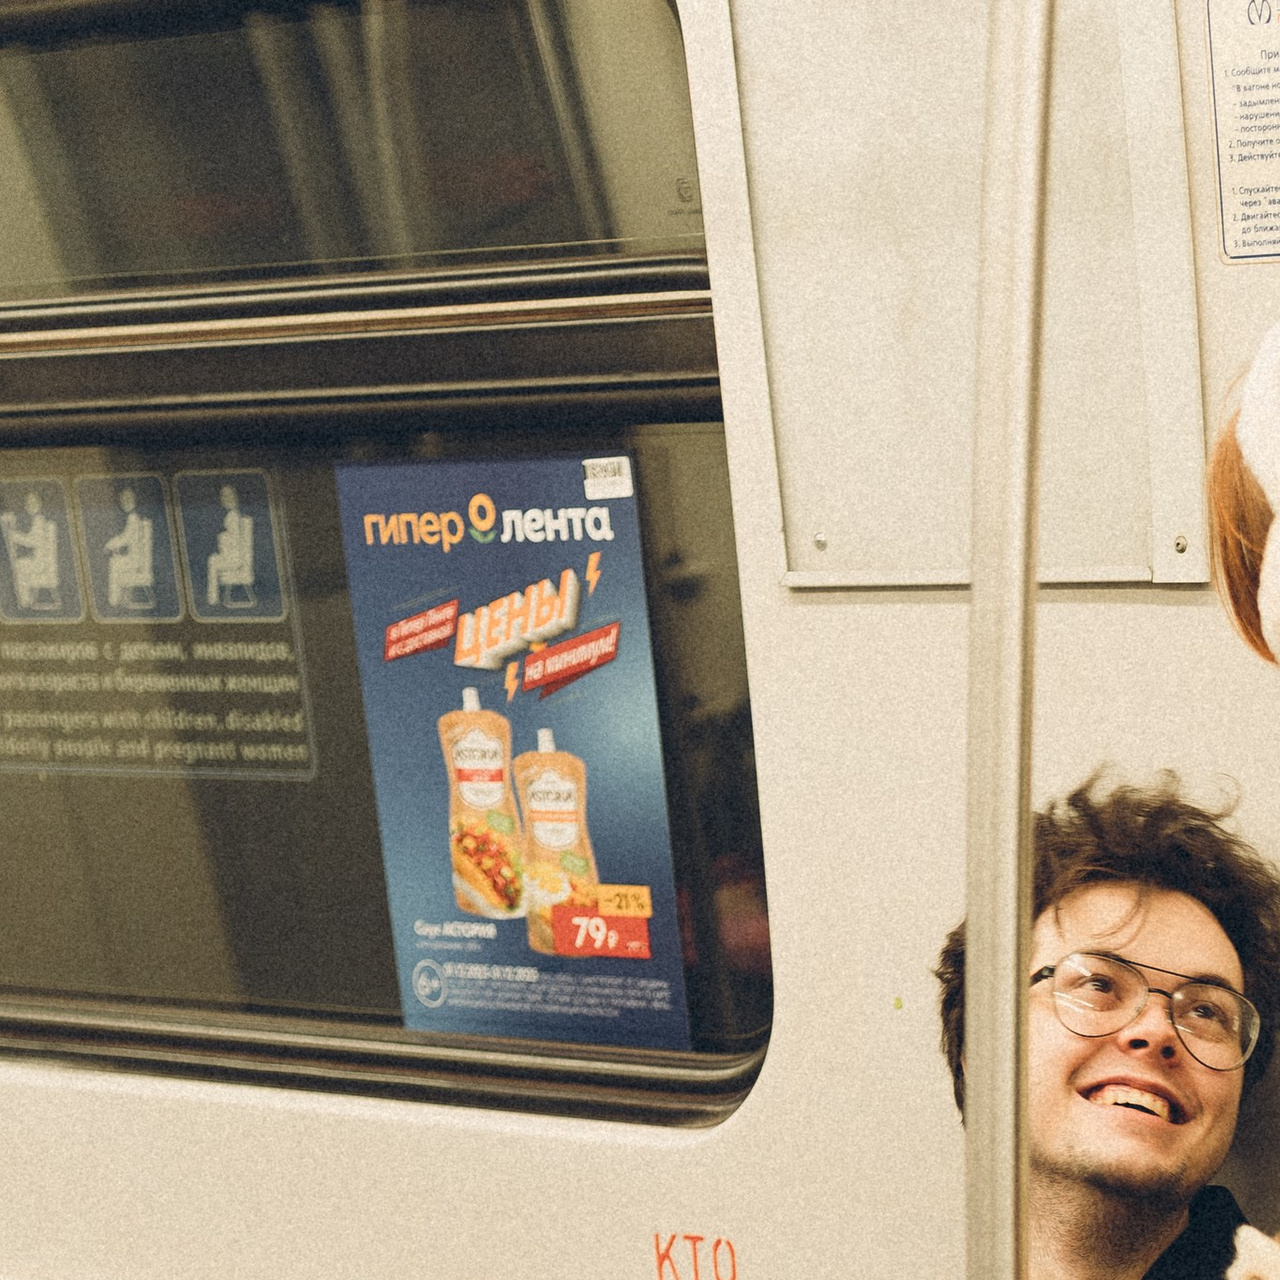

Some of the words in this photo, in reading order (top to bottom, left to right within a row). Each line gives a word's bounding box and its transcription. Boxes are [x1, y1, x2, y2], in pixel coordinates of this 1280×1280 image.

[1261, 50, 1279, 61] При
[1231, 67, 1271, 76] Сообщите
[1243, 83, 1269, 91] вагоне
[1237, 139, 1273, 148] Получите
[1240, 199, 1261, 208] через
[363, 510, 465, 553] гипер
[500, 506, 615, 544] лента
[454, 567, 580, 669] ЦЕНЫ
